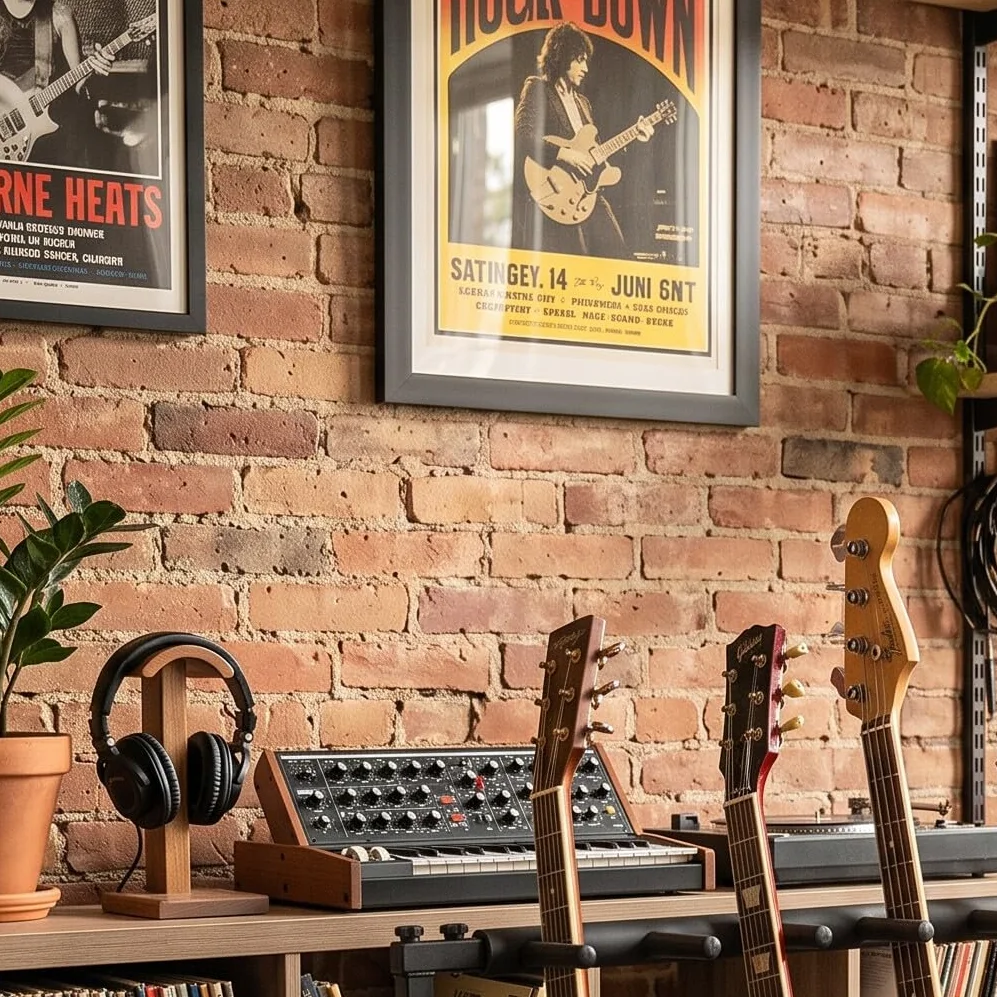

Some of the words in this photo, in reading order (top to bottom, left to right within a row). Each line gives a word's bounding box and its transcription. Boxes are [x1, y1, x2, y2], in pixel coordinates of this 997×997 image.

[65, 176, 163, 230] HEATS
[549, 267, 568, 290] 14
[611, 273, 652, 299] JUNI
